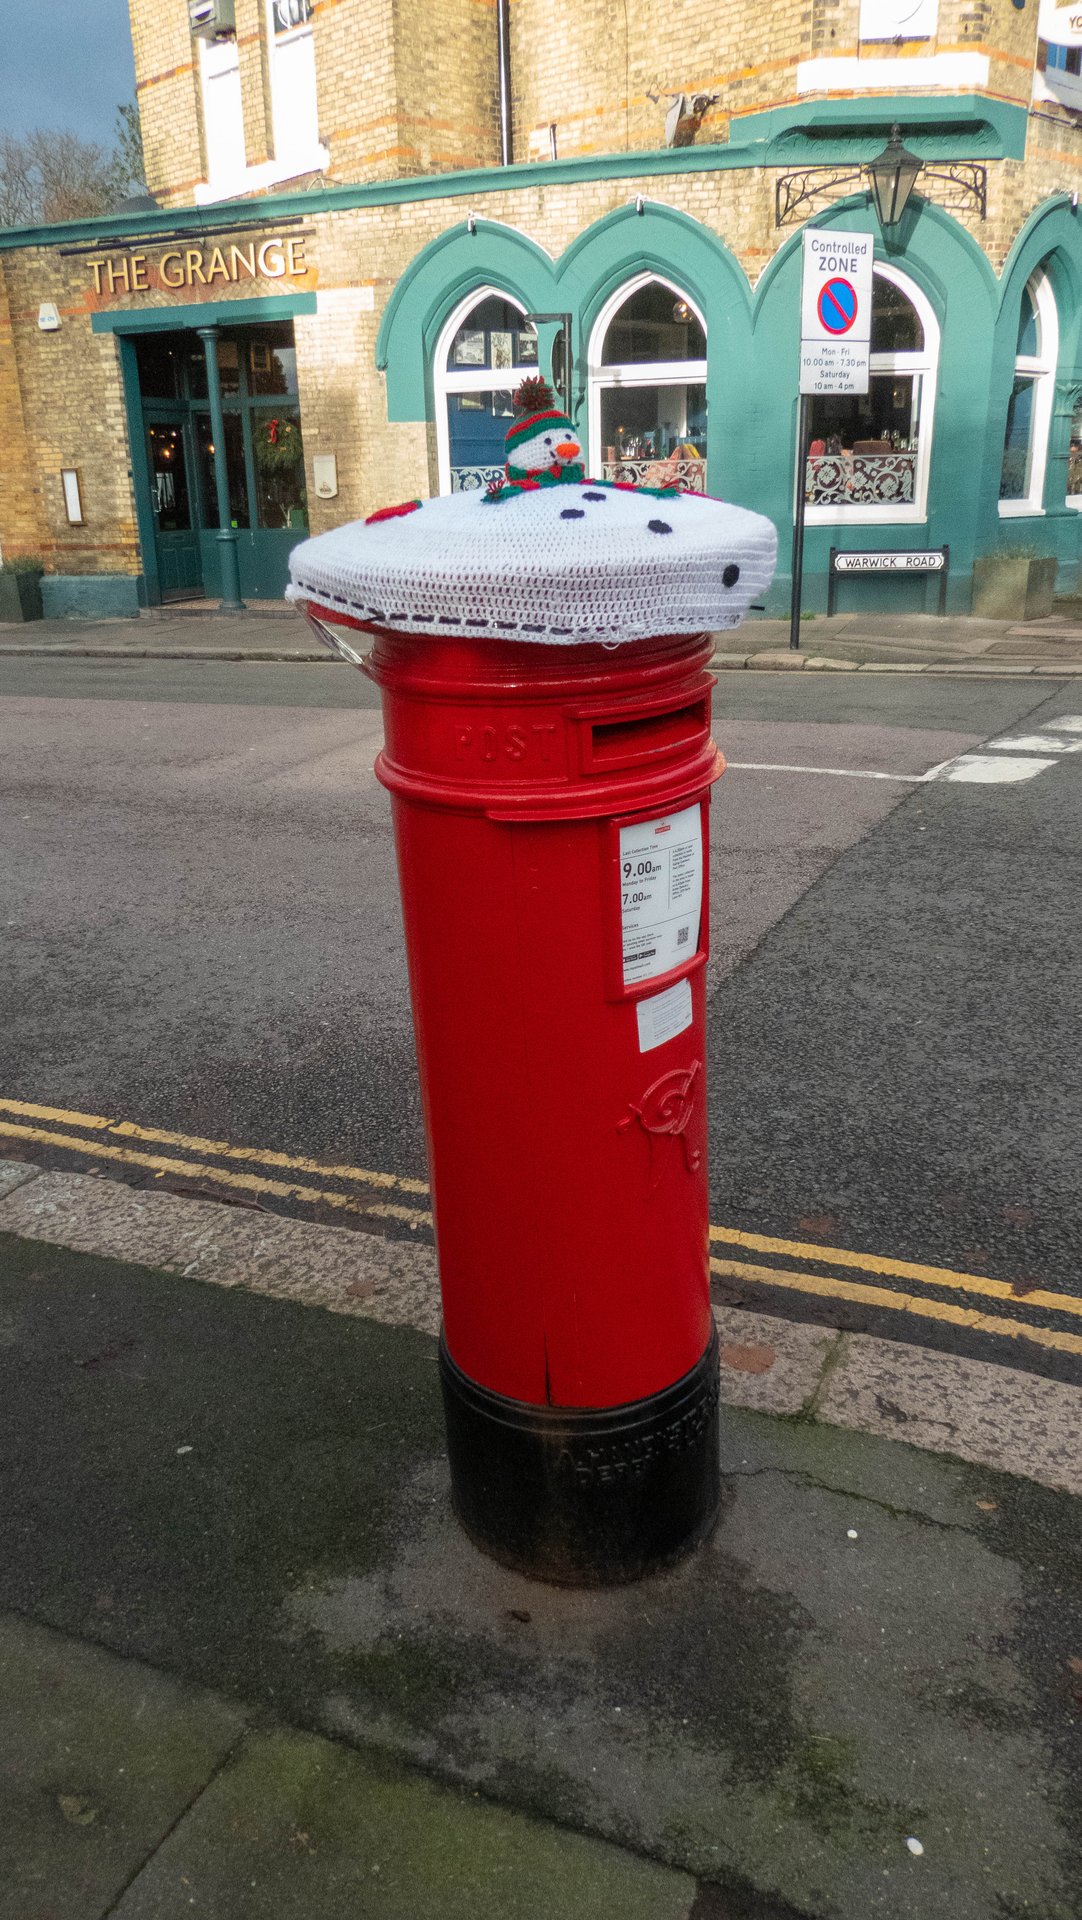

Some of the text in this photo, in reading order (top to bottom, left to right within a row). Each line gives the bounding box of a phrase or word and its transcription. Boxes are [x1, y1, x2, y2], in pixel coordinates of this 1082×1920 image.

[811, 239, 867, 255] Controlled
[86, 237, 308, 294] THE GRANGE
[819, 256, 858, 273] ZONE
[821, 347, 836, 356] Mon
[840, 347, 850, 356] Fri
[856, 360, 867, 368] pm
[820, 370, 851, 380] Saturday
[814, 382, 823, 390] 10
[838, 382, 843, 390] 4
[844, 383, 855, 391] pm
[845, 556, 936, 568] WARWICK ROAD
[454, 723, 556, 762] POST
[623, 860, 662, 879] 9.00am
[622, 879, 638, 887] Monday
[622, 891, 653, 906] 7.00am
